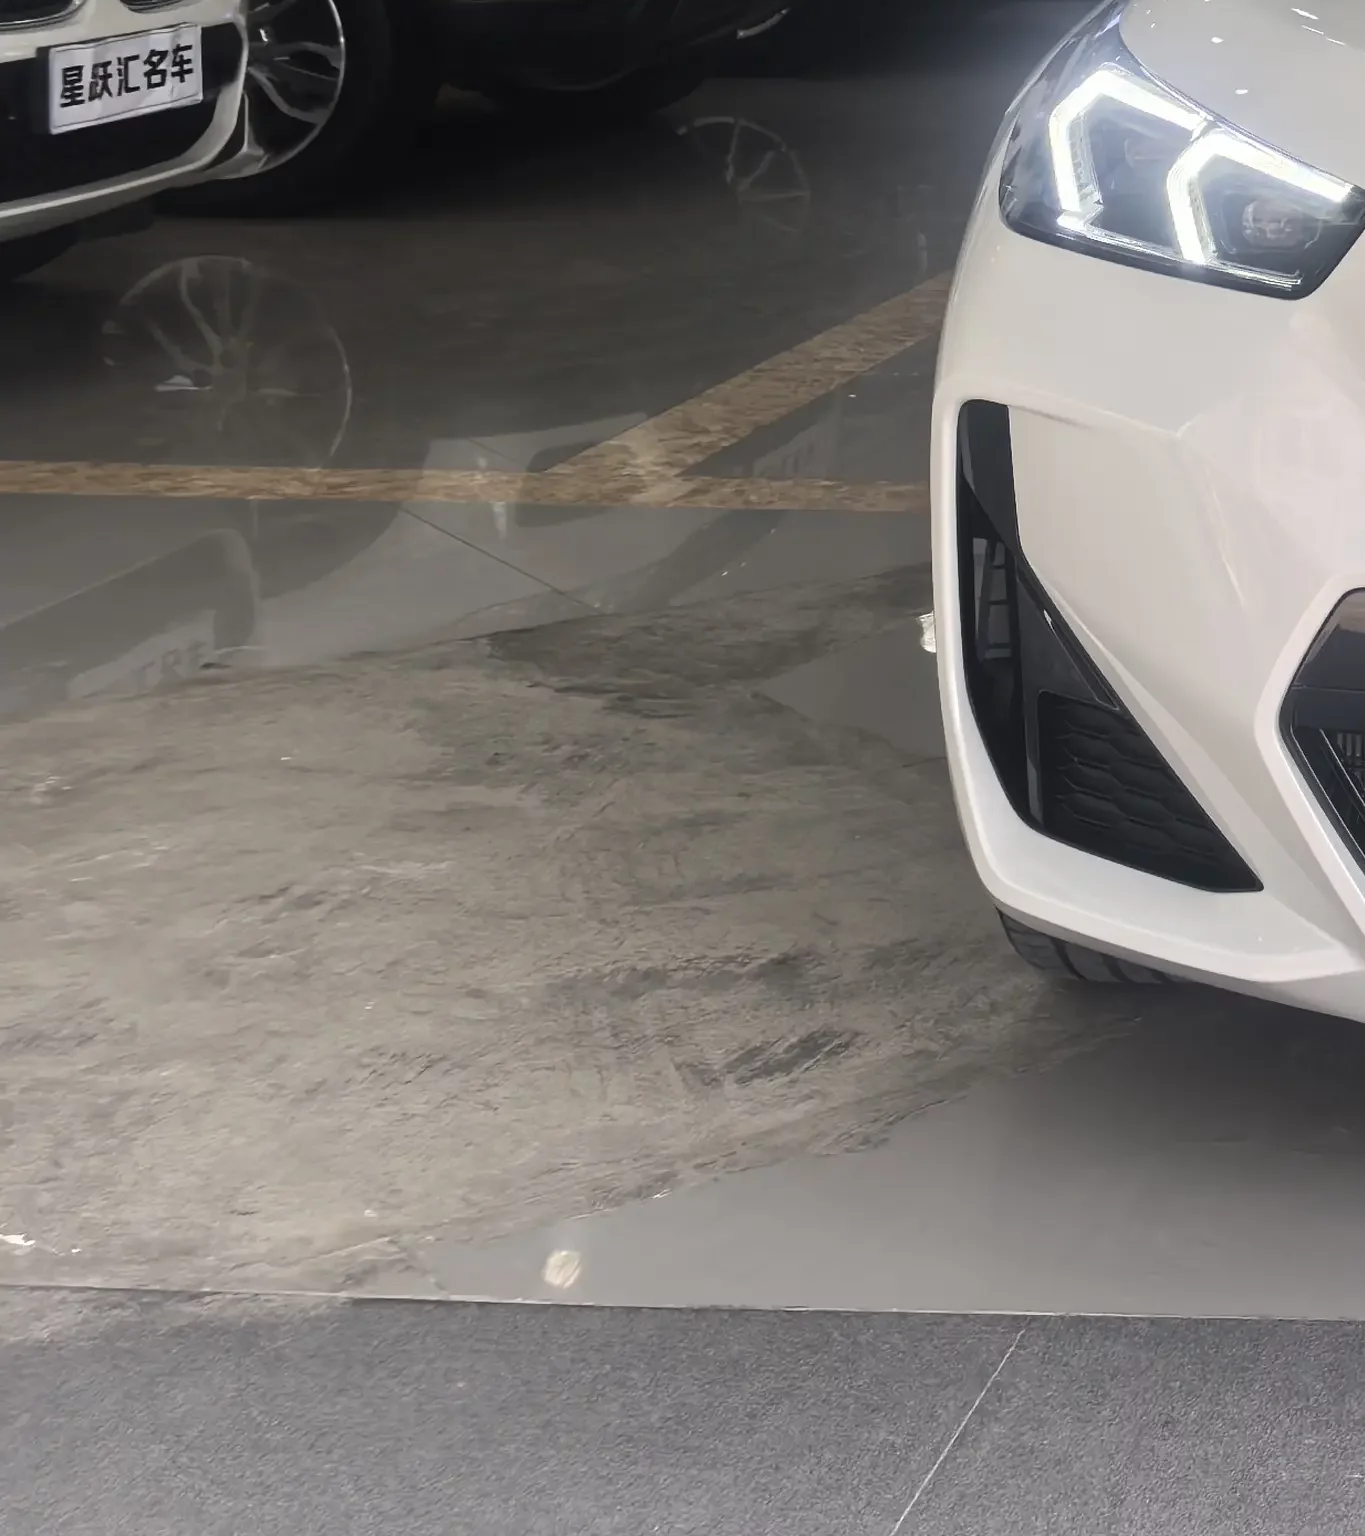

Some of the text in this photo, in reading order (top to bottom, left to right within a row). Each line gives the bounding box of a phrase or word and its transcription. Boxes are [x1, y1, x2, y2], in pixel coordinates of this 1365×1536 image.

[60, 43, 194, 108] 星跃汇名车
